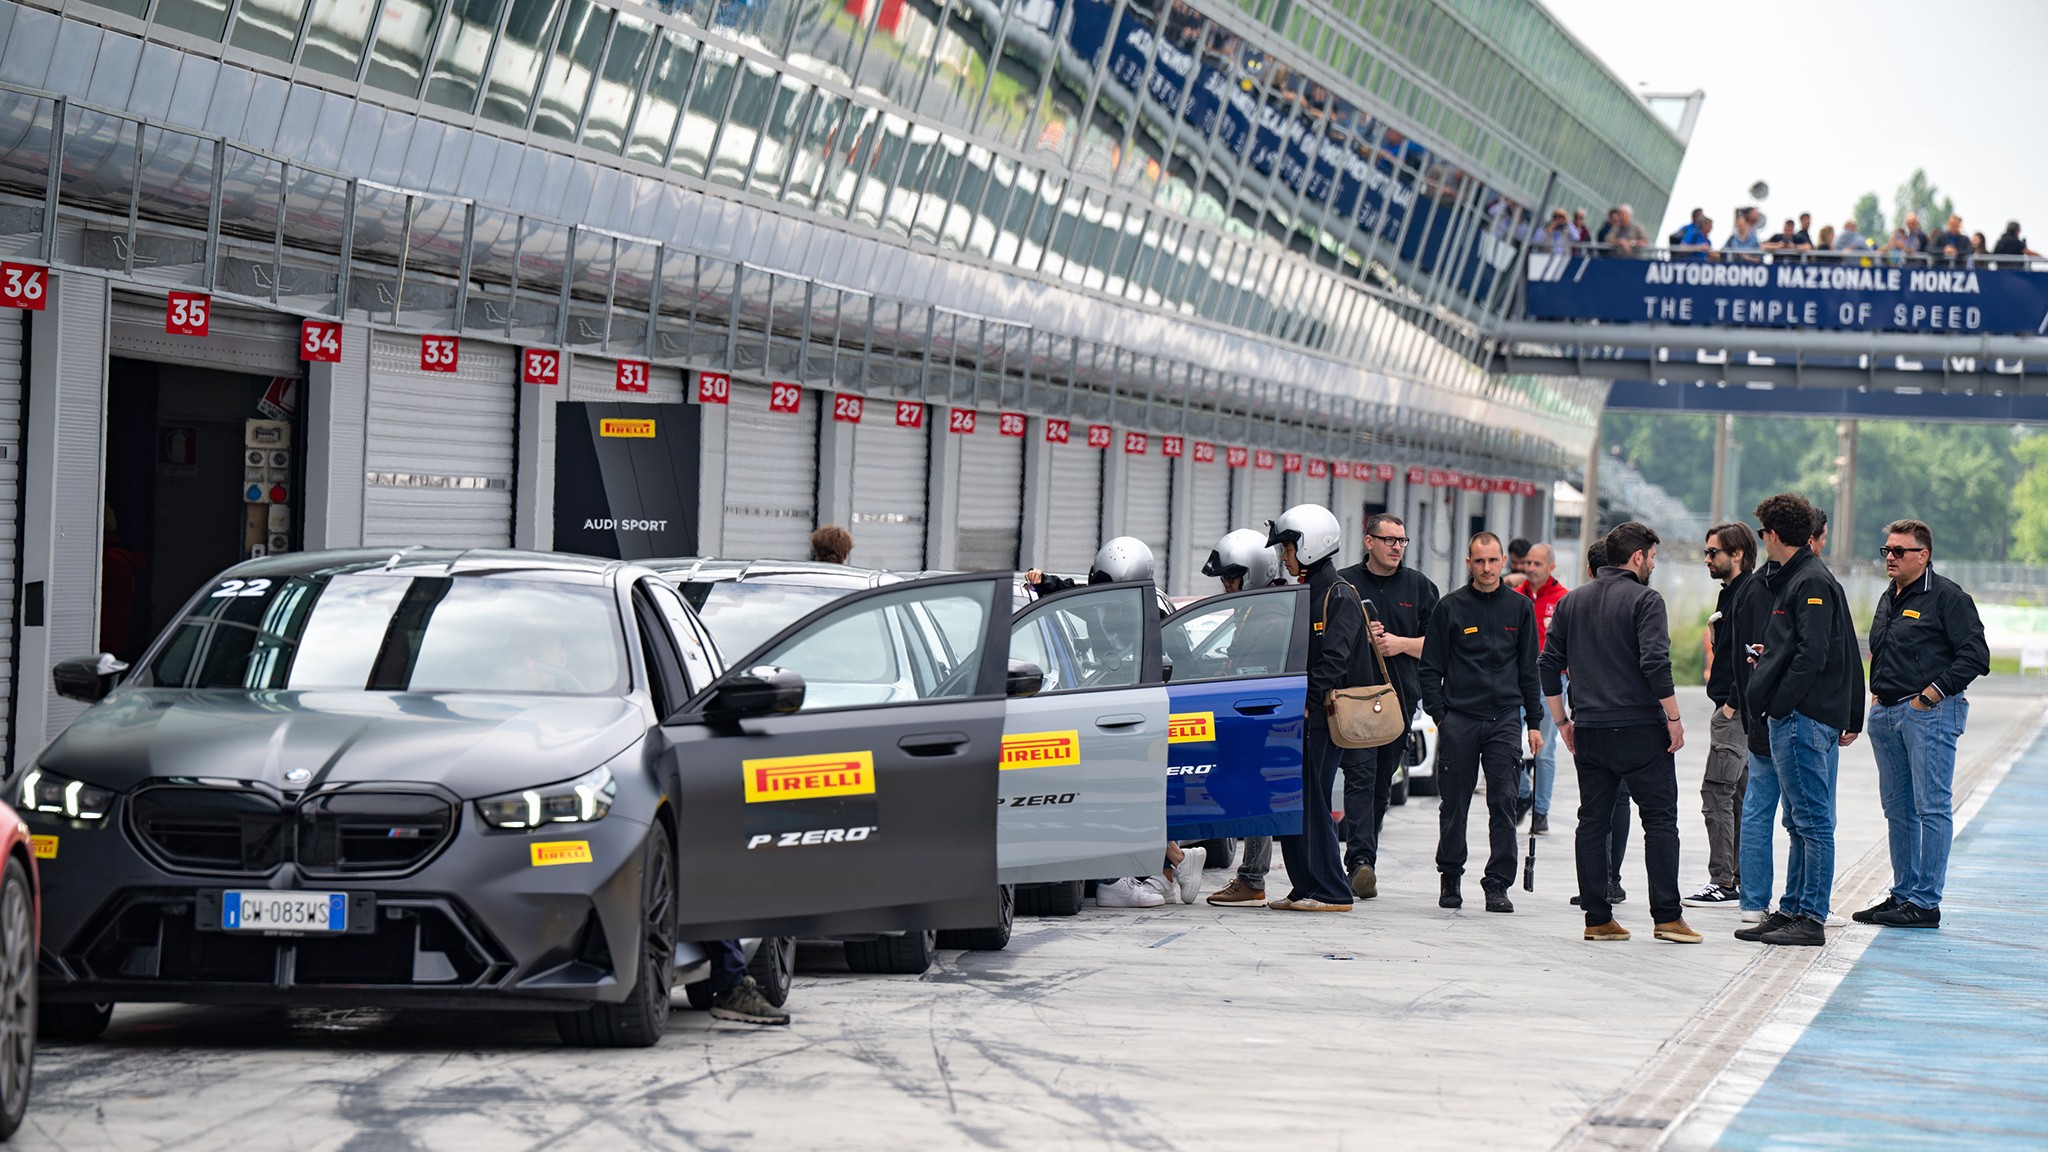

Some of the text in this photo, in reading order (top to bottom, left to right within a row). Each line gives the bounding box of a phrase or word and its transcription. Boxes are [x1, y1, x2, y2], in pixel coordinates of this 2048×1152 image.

[4, 268, 43, 300] 36
[1645, 262, 1980, 293] AUTODROMO NAZIONALE MONZA
[171, 298, 206, 327] 35
[1643, 296, 1981, 329] THE TEMPLE OF SPEED
[304, 326, 339, 354] 34
[424, 340, 454, 365] 33
[528, 354, 556, 377] 32
[620, 364, 645, 386] 31
[702, 377, 727, 398] 30
[774, 386, 798, 407] 29
[836, 397, 861, 416] 28
[898, 404, 919, 423] 27
[605, 422, 650, 434] PIRELLI
[952, 411, 973, 428] 26
[1002, 415, 1023, 433] 25
[1048, 422, 1068, 439] 24
[1089, 427, 1109, 445] 23
[1127, 435, 1145, 451] 22
[1165, 439, 1181, 454] 21
[1195, 444, 1212, 460] 20
[583, 518, 668, 532] AUDI SPORT
[211, 578, 272, 598] 22
[1168, 718, 1206, 737] ELLI
[756, 762, 861, 792] PIRELLI
[747, 834, 772, 850] P
[537, 845, 585, 860] PIRELLI
